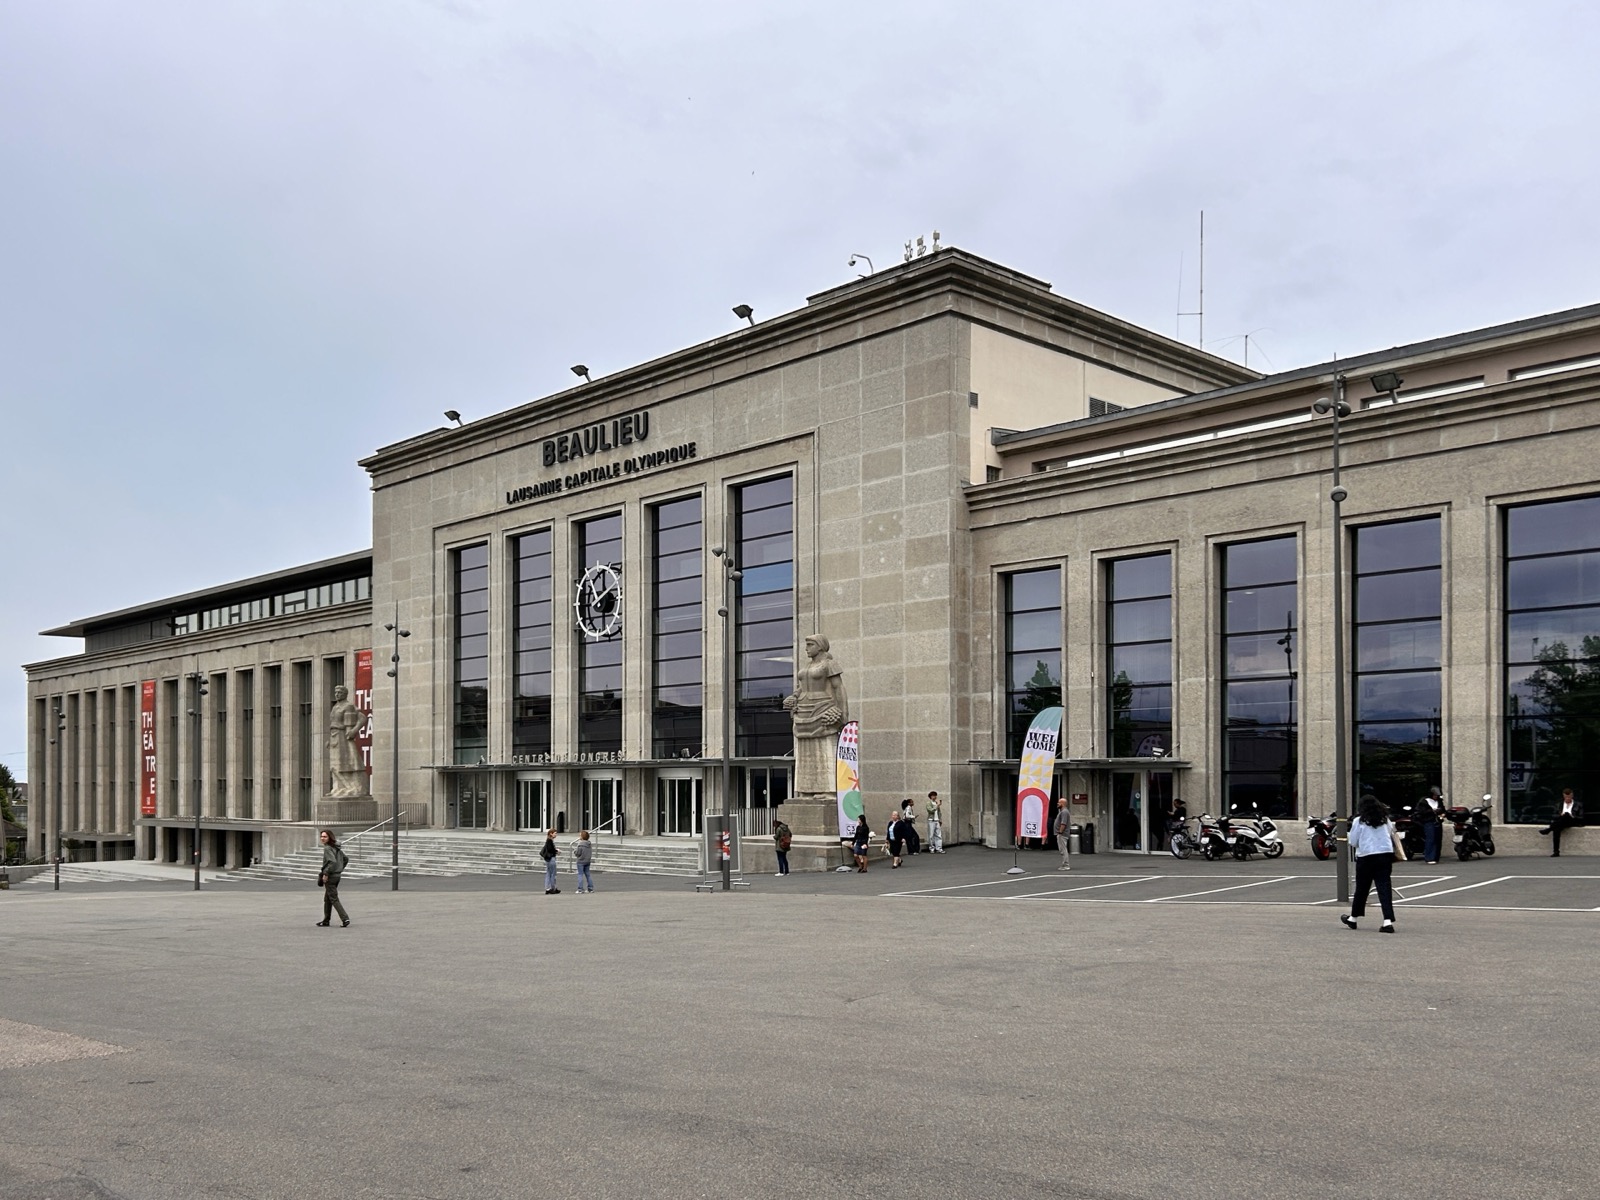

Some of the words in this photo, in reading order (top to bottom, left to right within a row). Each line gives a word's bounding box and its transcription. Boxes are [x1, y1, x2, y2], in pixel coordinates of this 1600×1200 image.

[543, 411, 649, 467] BEAULIEU
[506, 478, 562, 505] LAUSANNE
[565, 462, 620, 489] CAPITALE
[624, 442, 696, 473] OLYMPIQUE
[1026, 740, 1055, 752] COME
[1029, 732, 1056, 744] WEL
